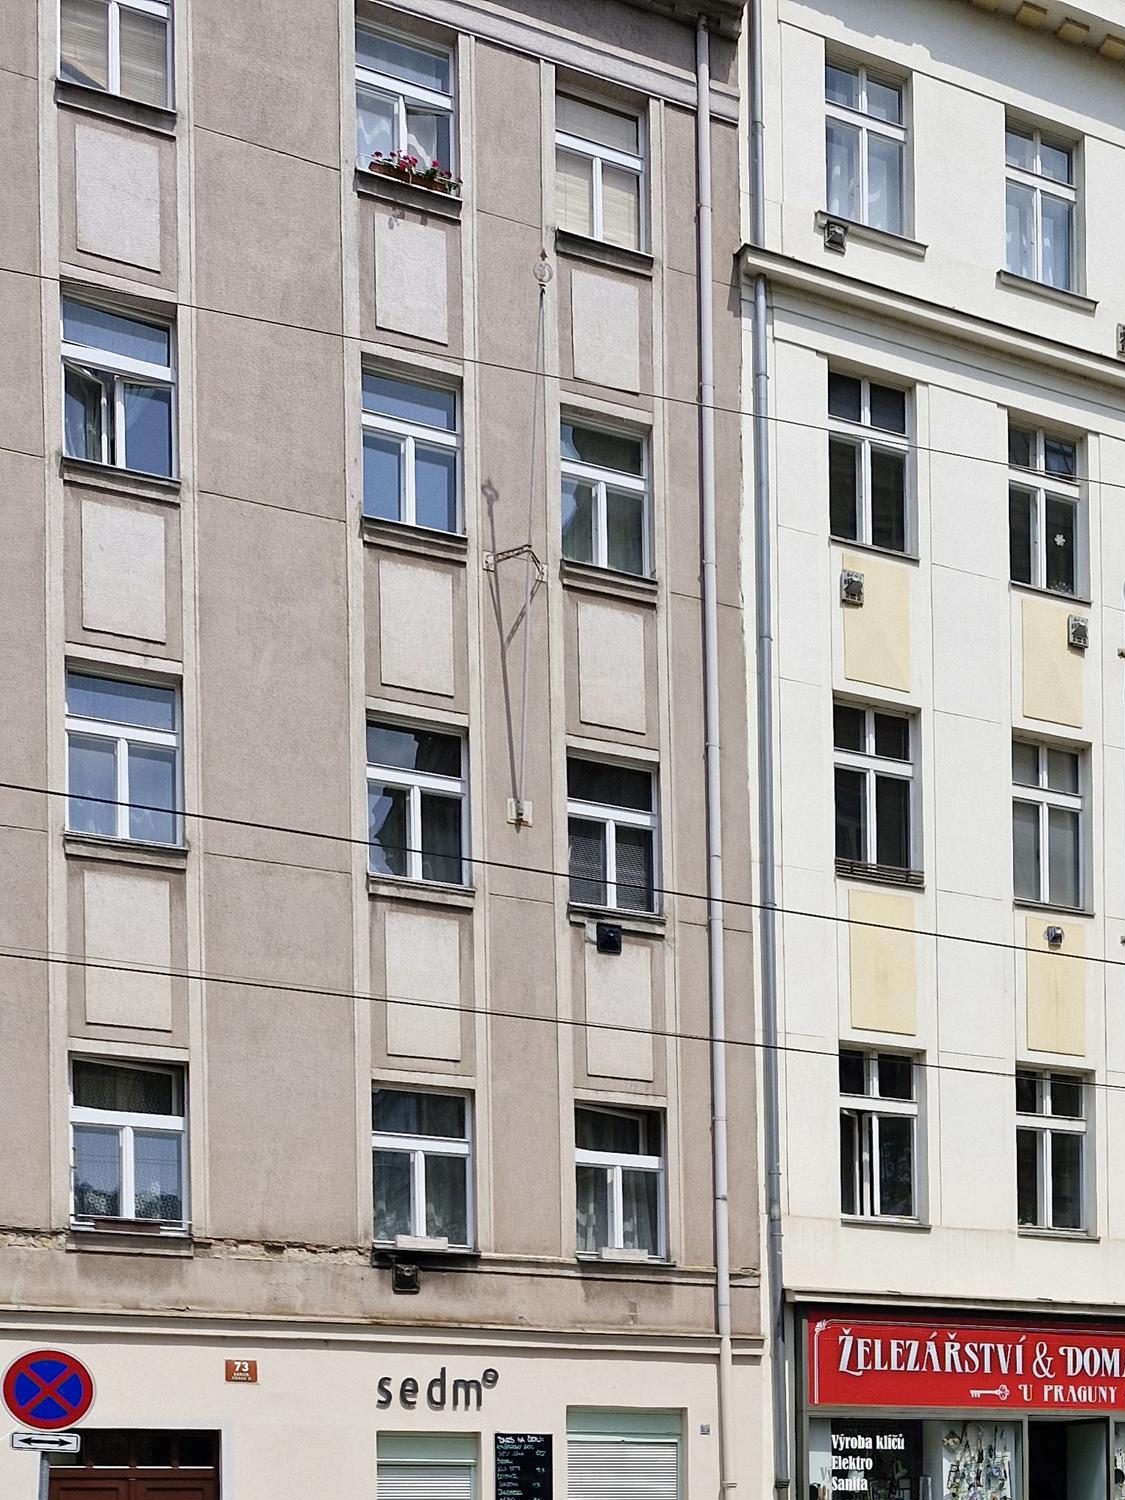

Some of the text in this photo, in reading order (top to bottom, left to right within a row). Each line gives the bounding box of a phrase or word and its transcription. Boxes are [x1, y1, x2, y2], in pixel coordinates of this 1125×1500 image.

[838, 1327, 1027, 1376] ŽELEZÁŘSTVÍ
[1032, 1341, 1056, 1379] &
[234, 1361, 249, 1371] 73
[1018, 1384, 1117, 1403] U PRAGUNY
[831, 1433, 905, 1450] Výroba klíčů
[831, 1455, 873, 1471] Elektro
[831, 1476, 868, 1491] Sanita
